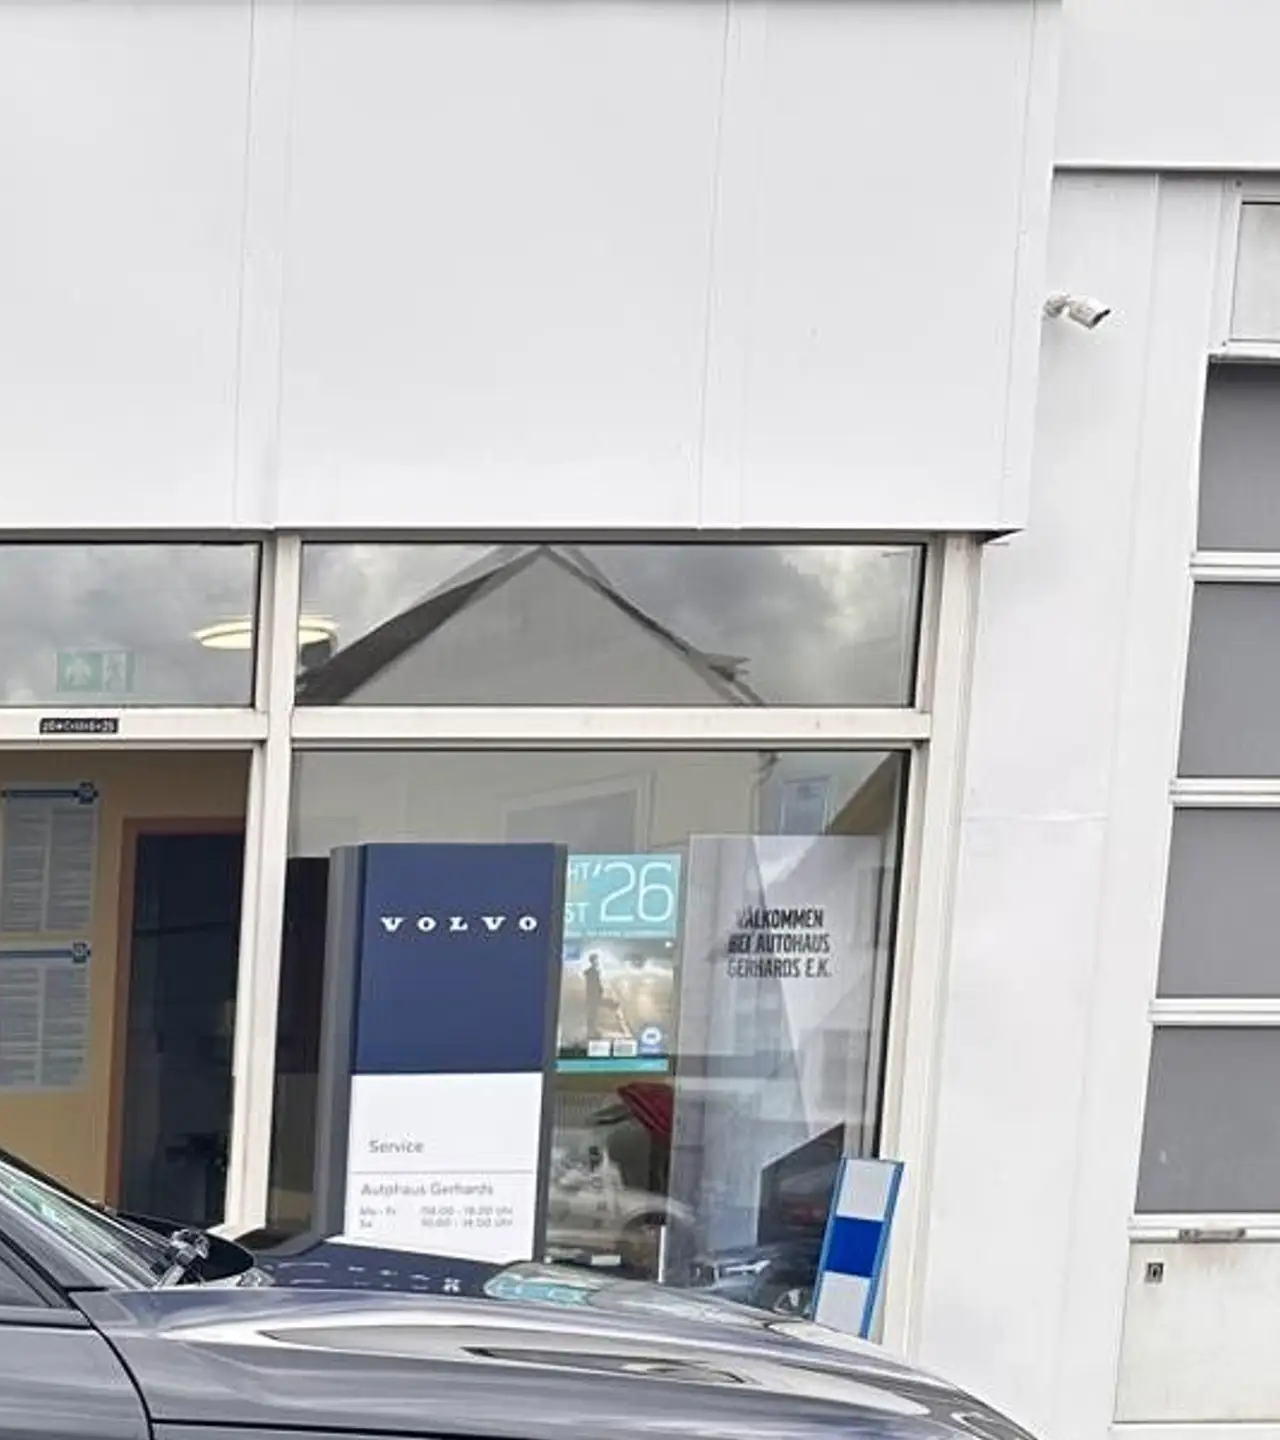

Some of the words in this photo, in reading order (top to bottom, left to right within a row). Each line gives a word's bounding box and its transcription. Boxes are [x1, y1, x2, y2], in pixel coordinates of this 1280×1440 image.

[379, 915, 538, 933] VOLVO
[755, 932, 831, 954] AUTOHAUS
[368, 1138, 424, 1154] Service
